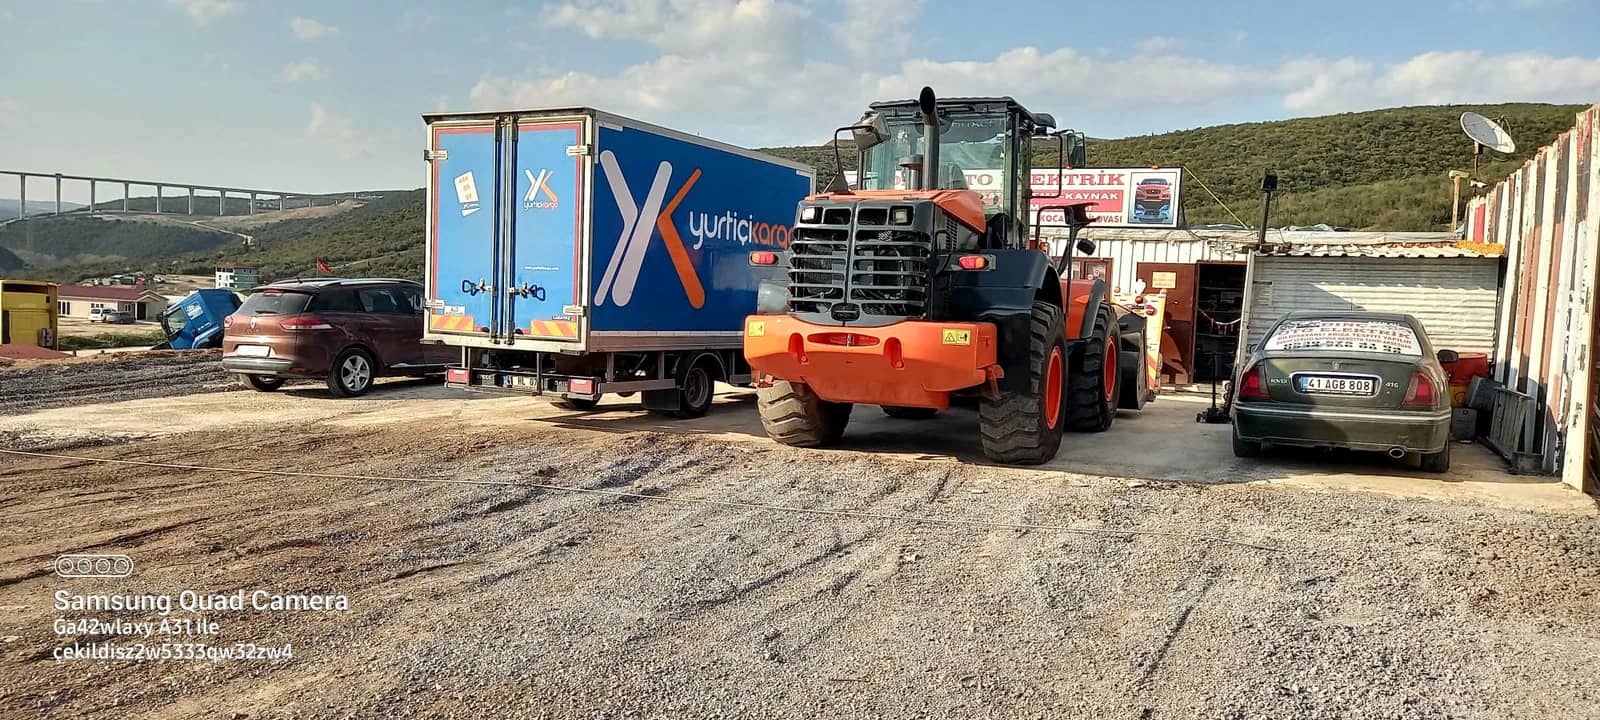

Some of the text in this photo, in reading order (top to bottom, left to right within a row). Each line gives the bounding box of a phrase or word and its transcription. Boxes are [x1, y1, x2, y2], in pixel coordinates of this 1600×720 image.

[1031, 170, 1125, 186] EKTRİK
[1308, 379, 1370, 391] 41 AGB 808
